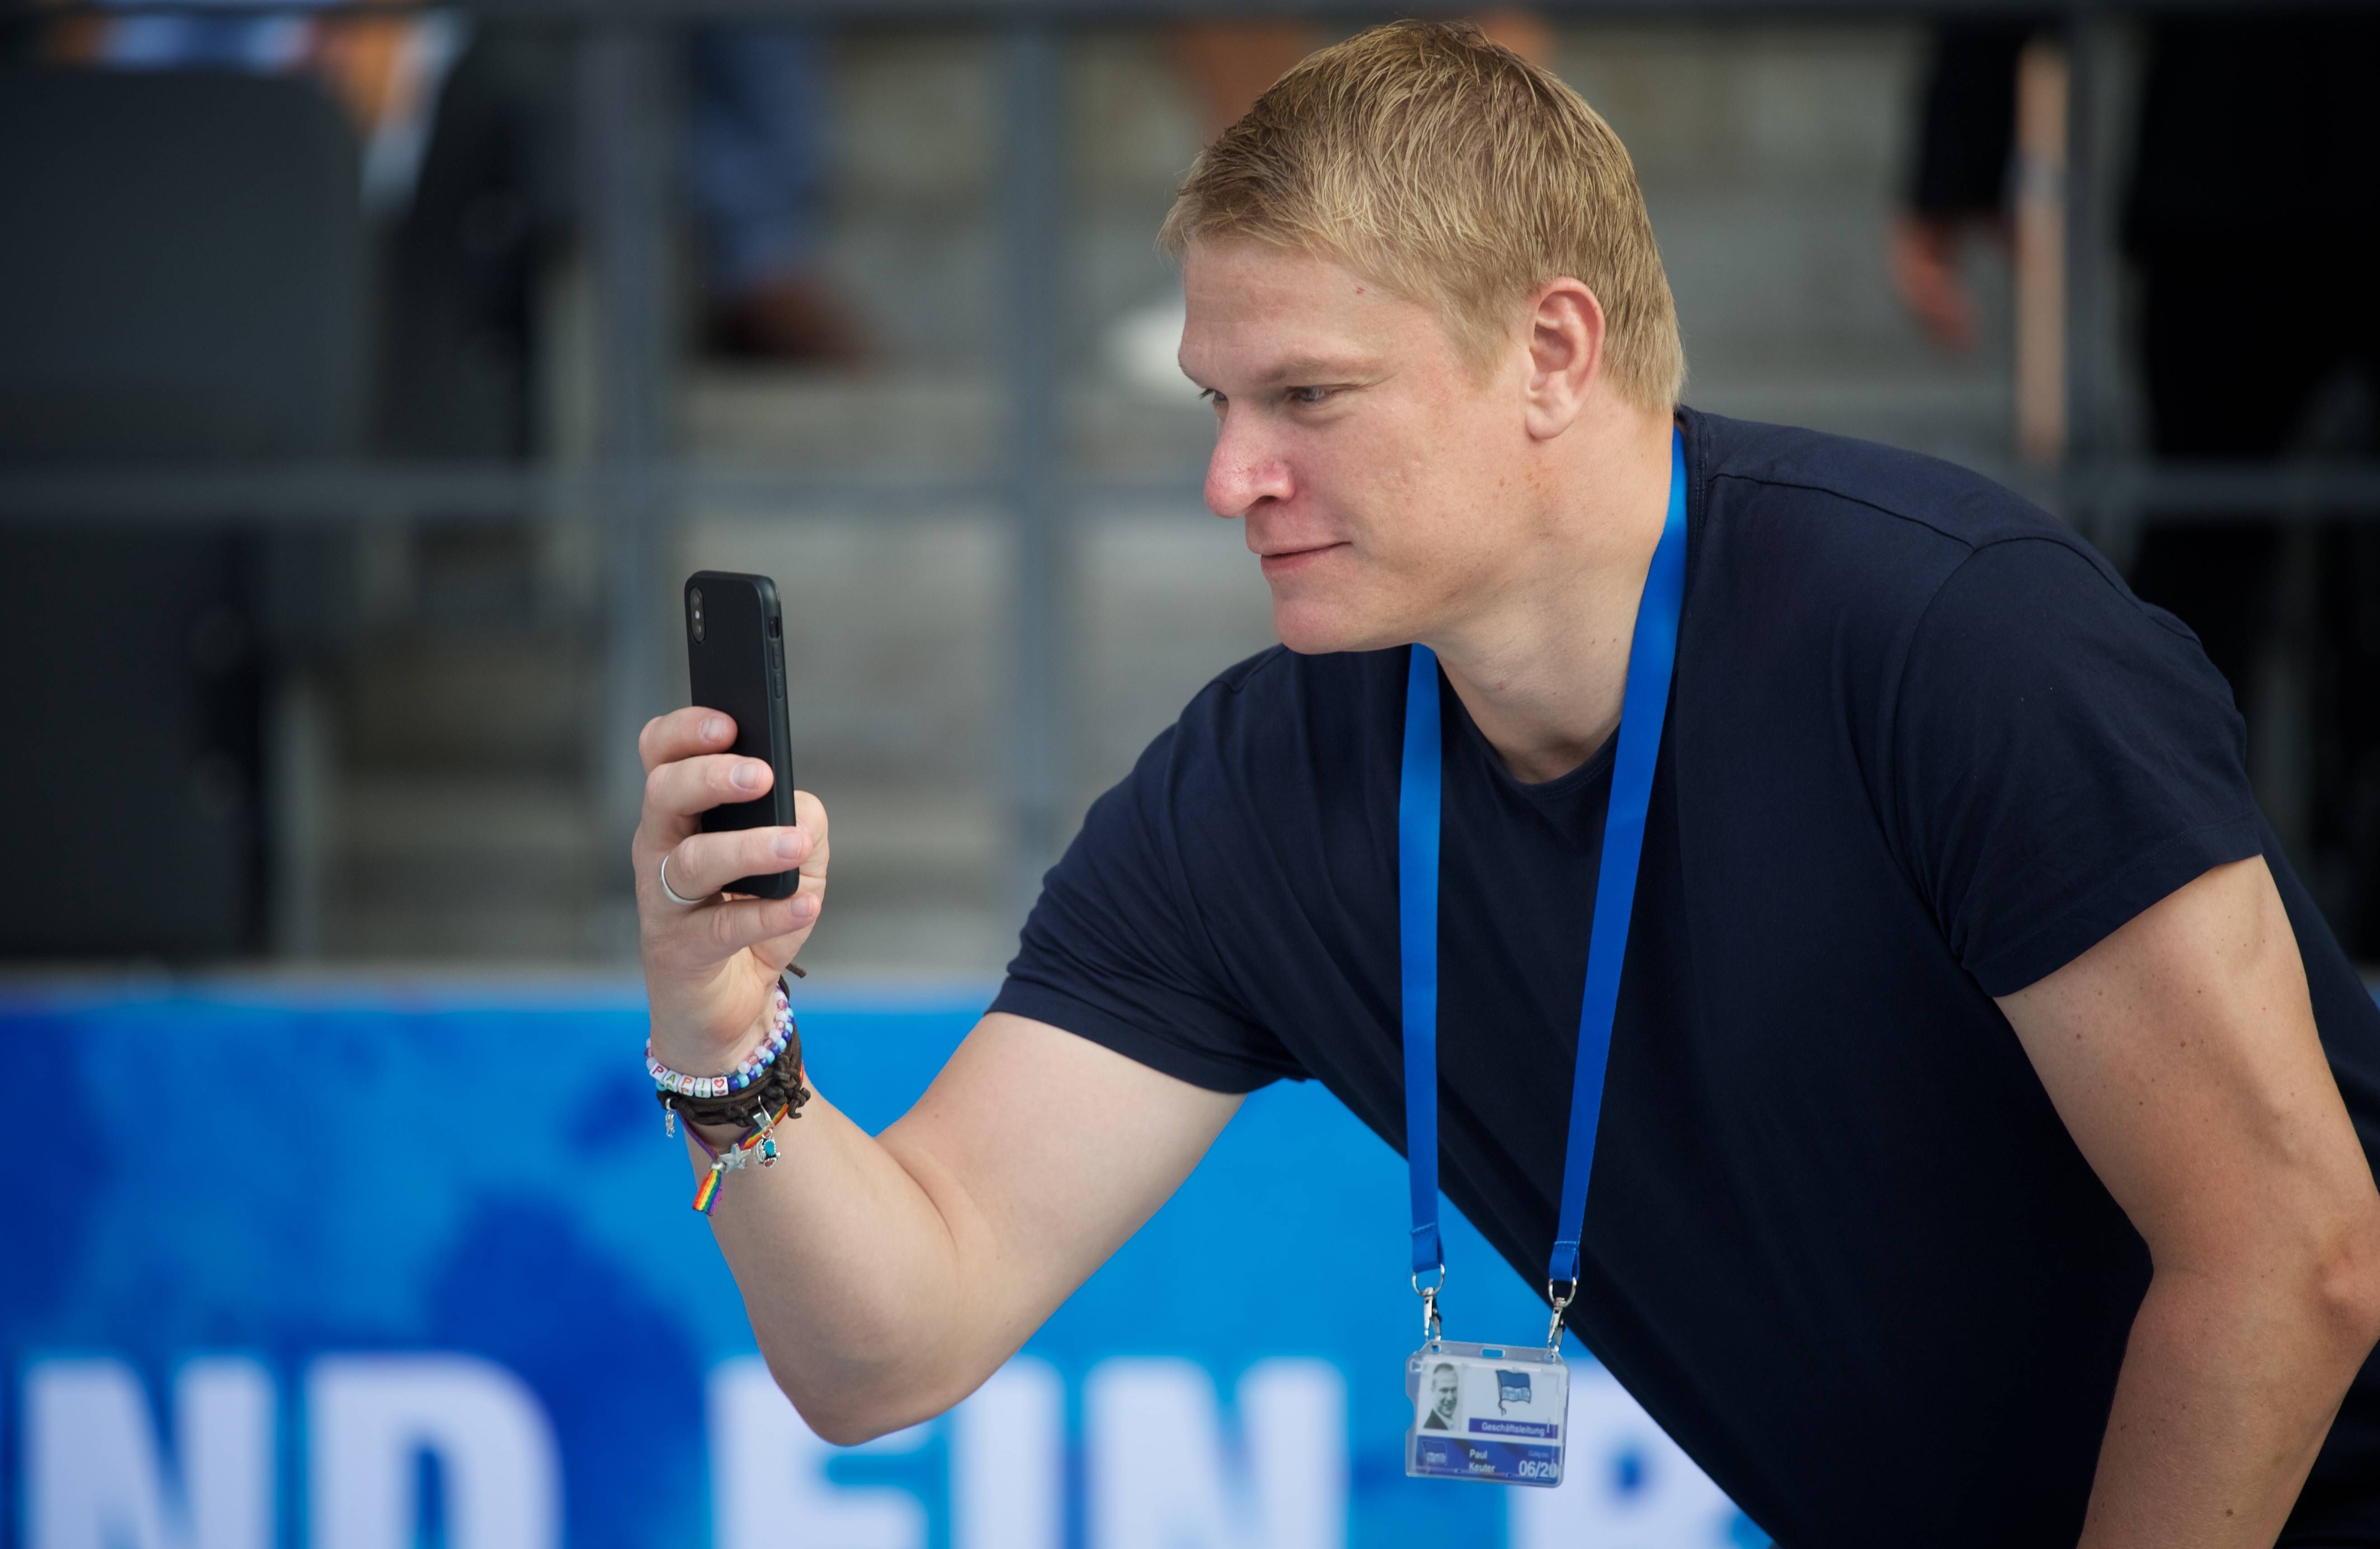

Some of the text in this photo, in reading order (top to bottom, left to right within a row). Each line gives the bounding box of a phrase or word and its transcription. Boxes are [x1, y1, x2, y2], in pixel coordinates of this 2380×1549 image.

[652, 1065, 705, 1088] PAPI
[1481, 1422, 1546, 1437] Geschäftsleitung
[1469, 1449, 1488, 1460] Paul
[1469, 1462, 1496, 1474] Keuter
[1518, 1460, 1558, 1479] 06/20
